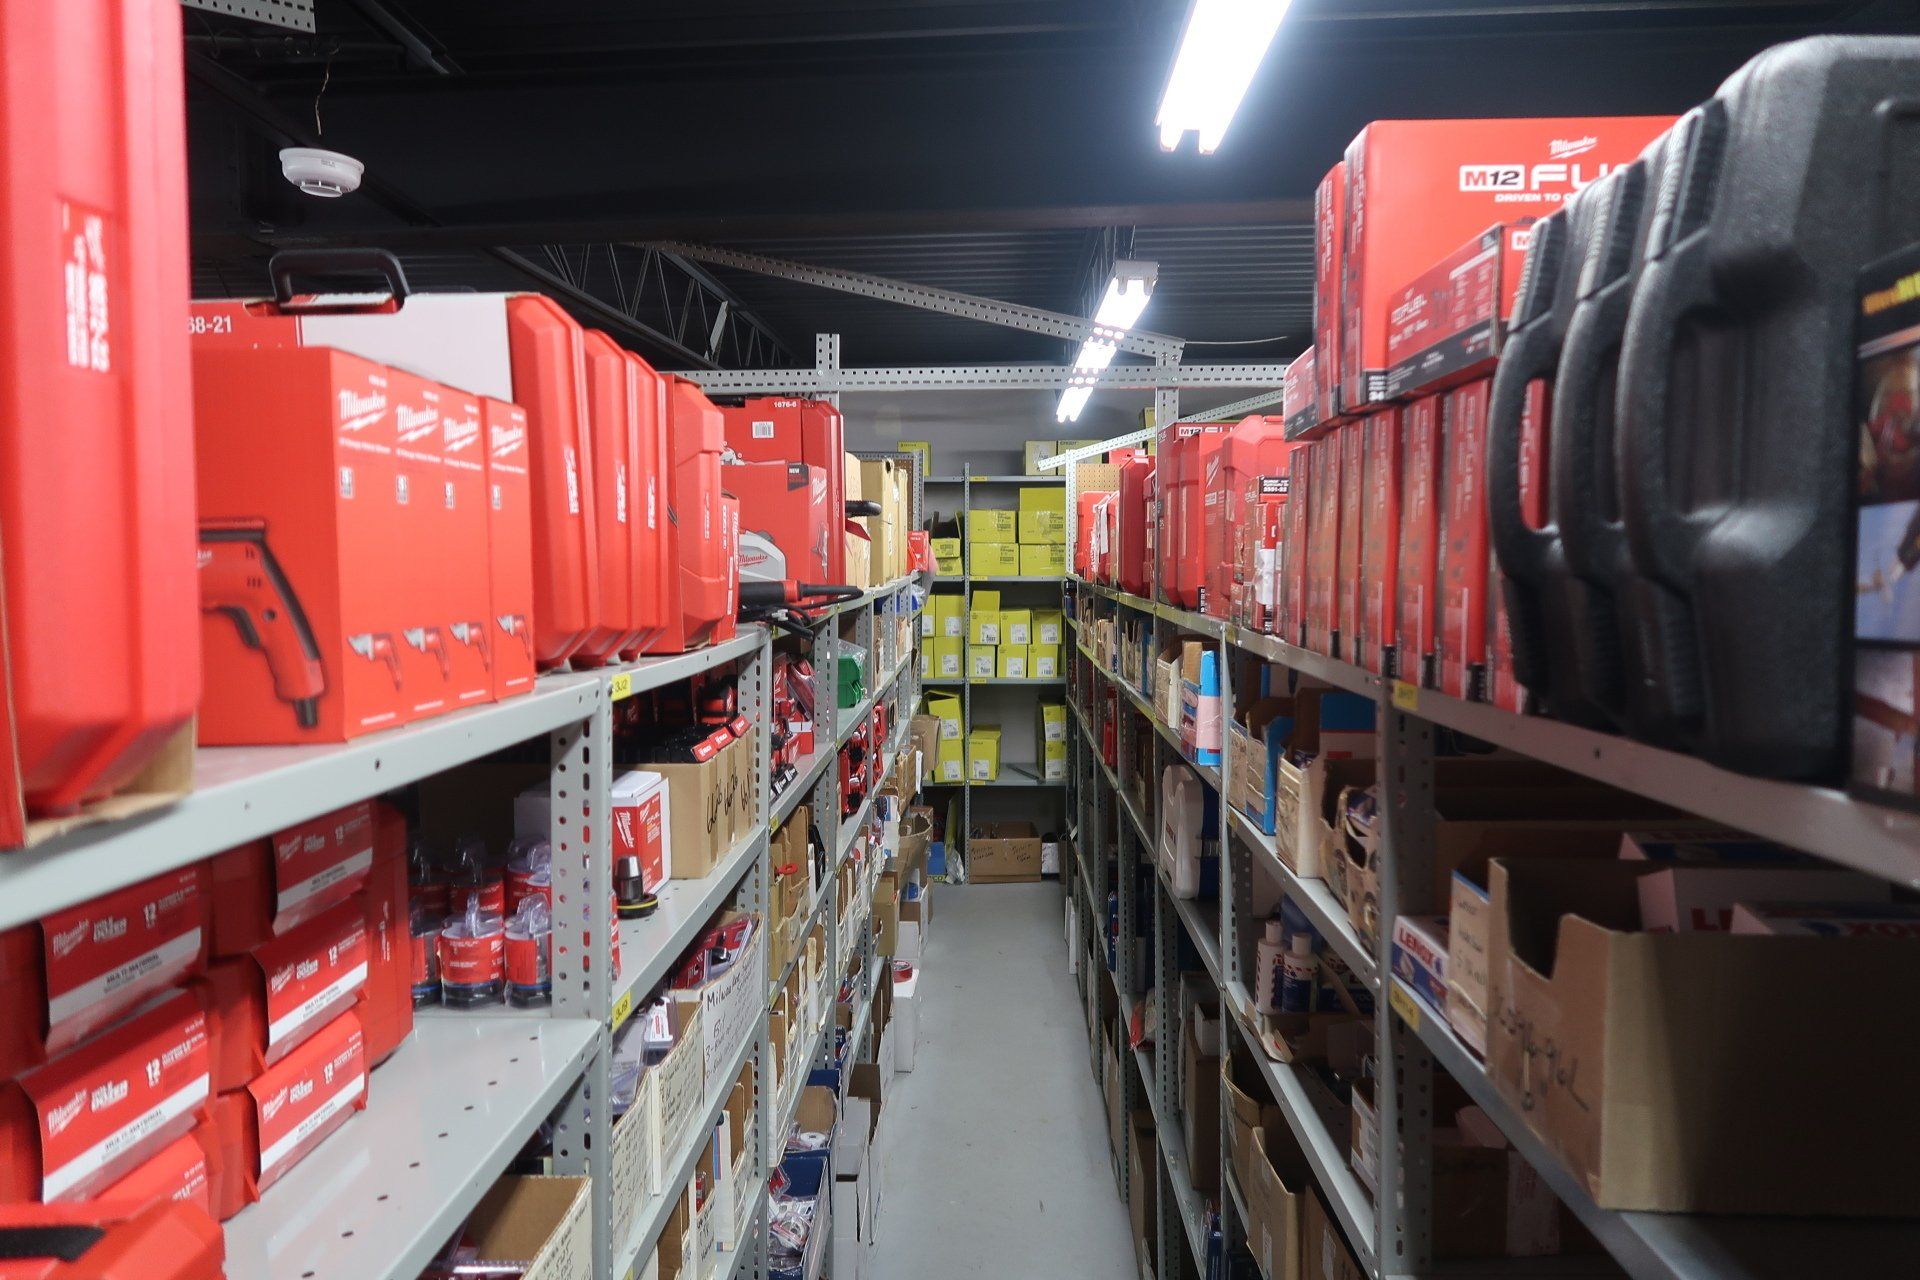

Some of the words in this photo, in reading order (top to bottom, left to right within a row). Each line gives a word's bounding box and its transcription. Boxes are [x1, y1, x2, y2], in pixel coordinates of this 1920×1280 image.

[1549, 136, 1598, 153] Milwaukee
[1465, 171, 1520, 186] M12
[1494, 193, 1541, 203] DRIVEN
[1544, 193, 1561, 202] TO
[339, 389, 387, 420] Milwaukee
[396, 404, 439, 433] Milwaukee
[328, 946, 338, 961] 12
[1399, 928, 1435, 967] LENOX
[146, 1058, 160, 1081] 12
[324, 1062, 334, 1080] 12
